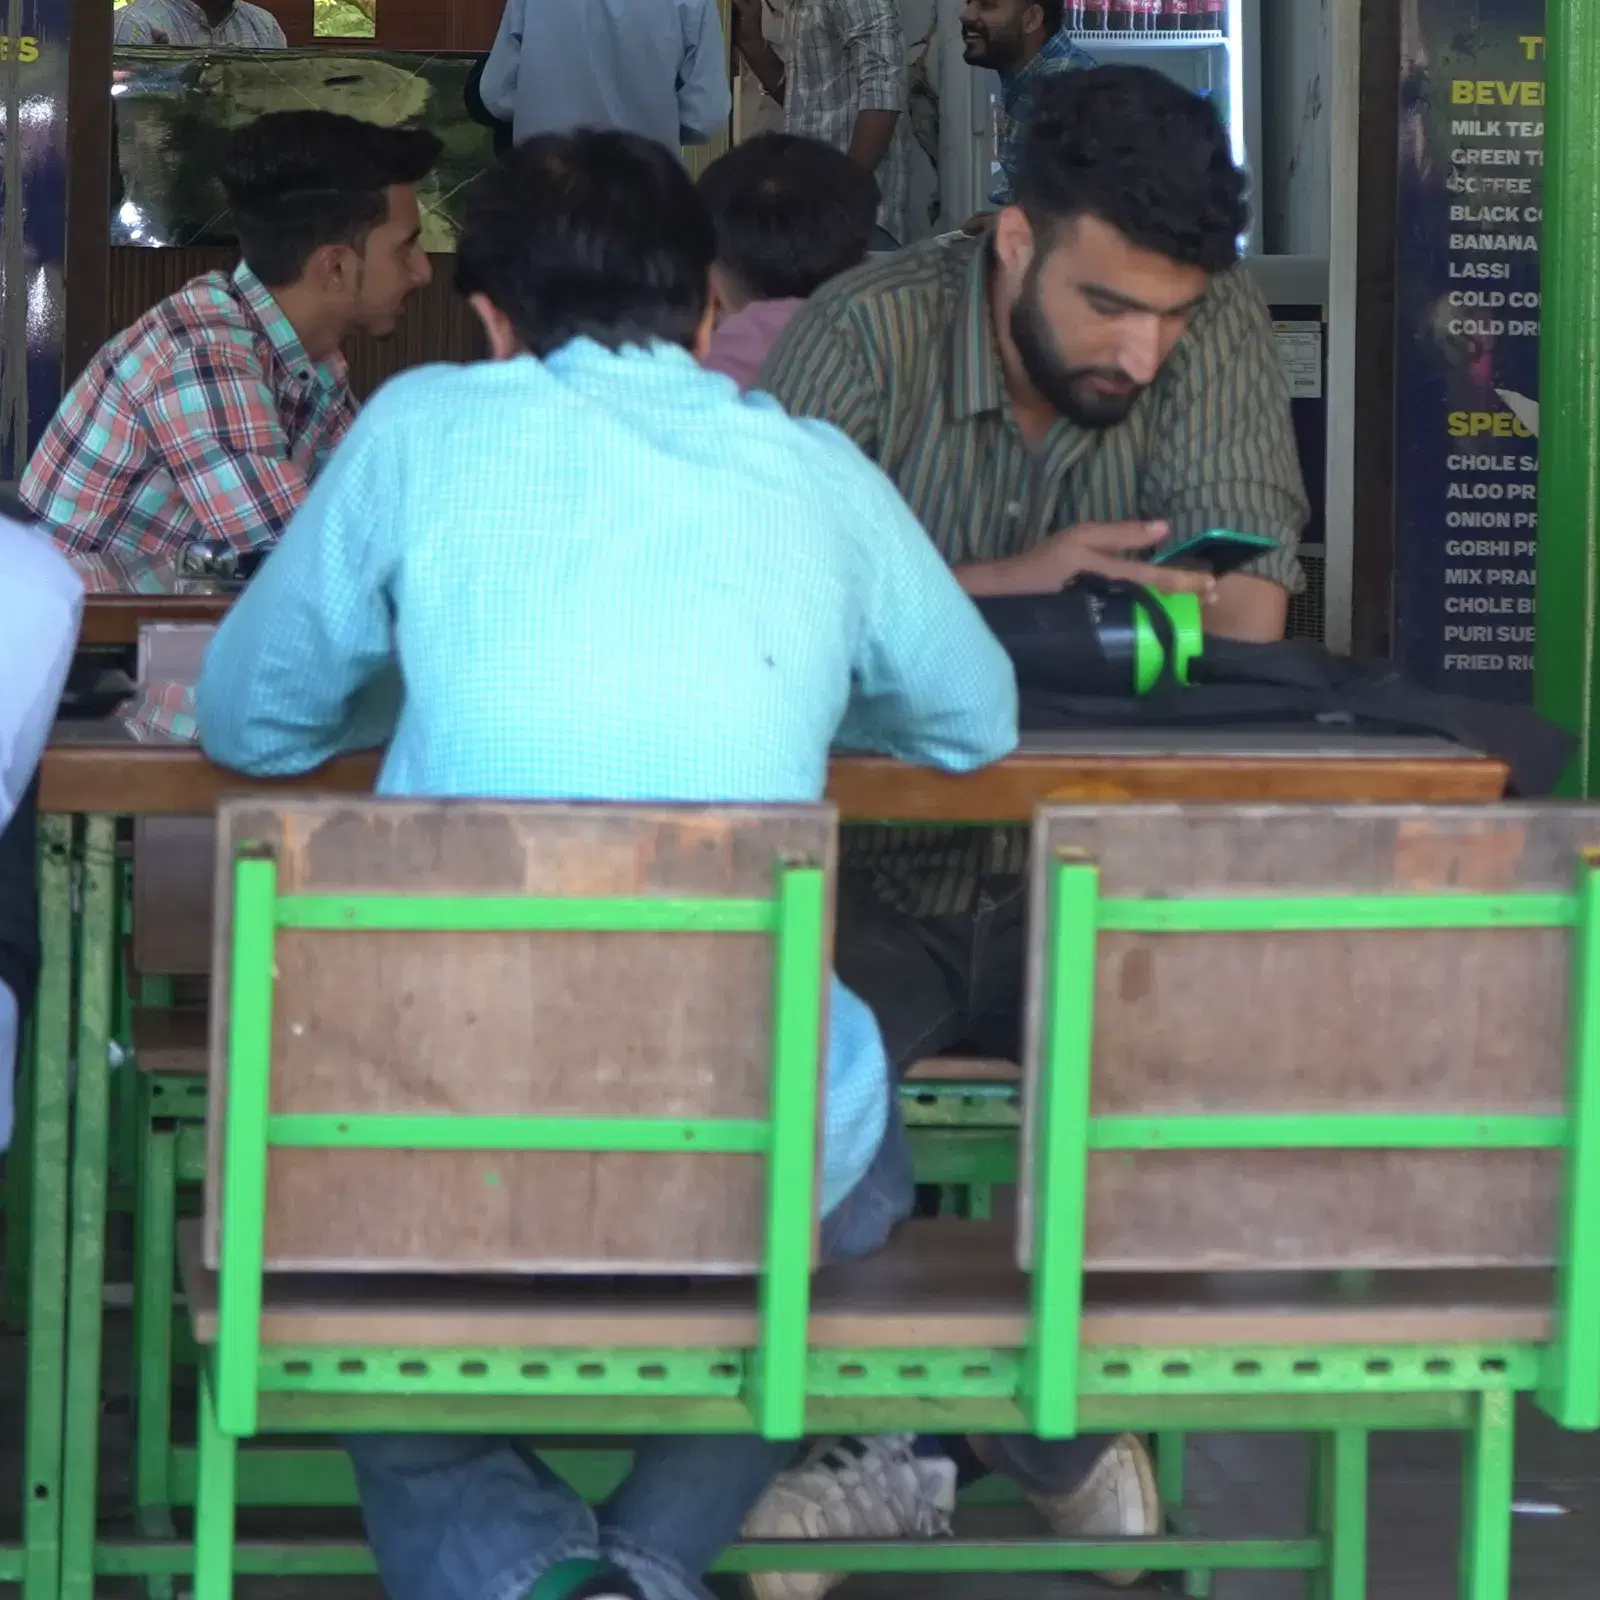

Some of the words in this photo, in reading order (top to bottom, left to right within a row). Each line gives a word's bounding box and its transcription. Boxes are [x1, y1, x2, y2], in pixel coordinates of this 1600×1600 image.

[1452, 119, 1502, 136] MILK
[1450, 148, 1520, 166] GREEN
[1450, 204, 1520, 223] BLACK
[1449, 233, 1538, 251] BANANA
[1449, 262, 1510, 280] LASSI
[1448, 290, 1505, 308] COLD
[1448, 318, 1504, 336] COLD
[1446, 454, 1516, 472] CHOLE
[1446, 483, 1504, 500] ALOO
[1445, 511, 1510, 528] ONION
[1445, 540, 1510, 557] GOBHI
[1444, 568, 1483, 585] MIX
[1444, 597, 1514, 614] CHOLE
[1444, 625, 1493, 642] PURI
[1443, 654, 1504, 670] FRIED
